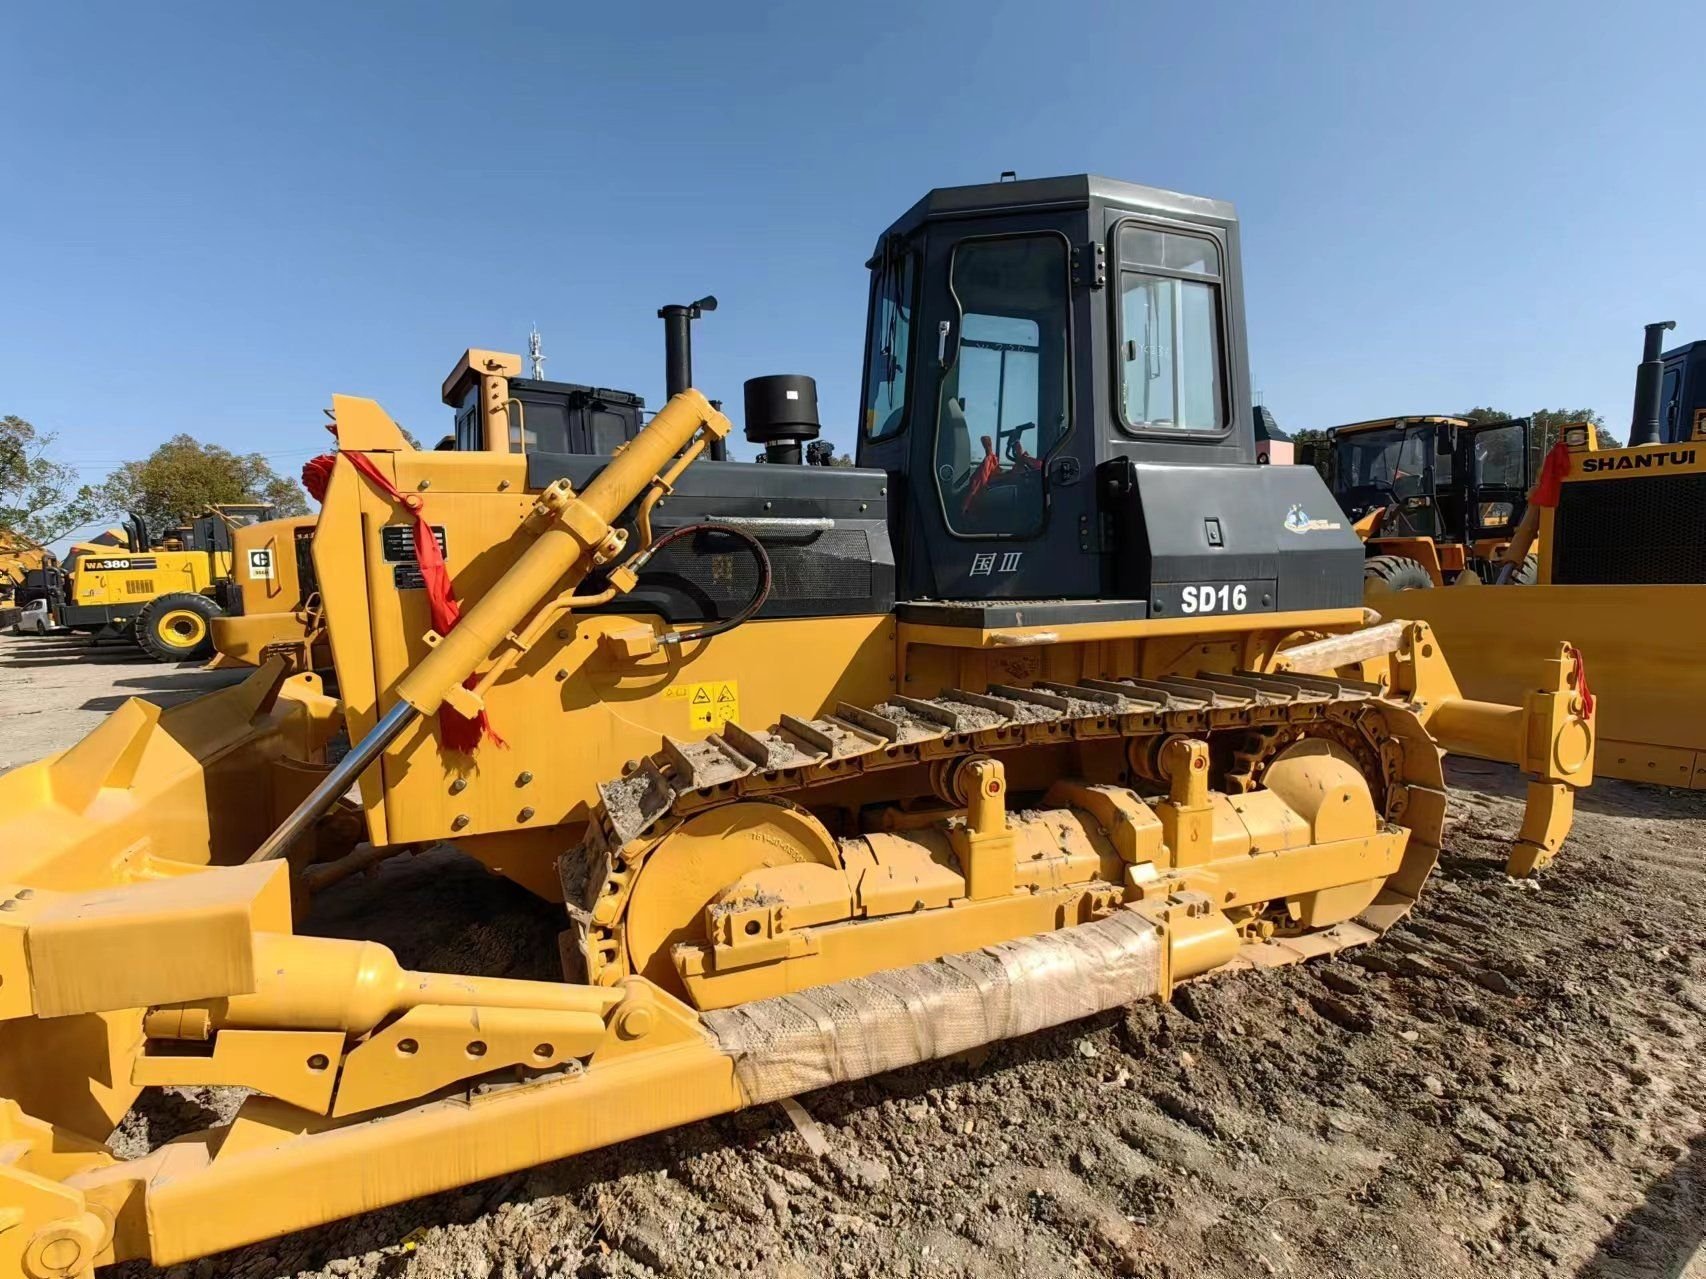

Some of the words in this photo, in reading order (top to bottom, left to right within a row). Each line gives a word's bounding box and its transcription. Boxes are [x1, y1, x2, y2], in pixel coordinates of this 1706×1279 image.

[1582, 450, 1696, 472] SHANTUI
[86, 560, 130, 570] WA380
[1181, 584, 1247, 613] SD16
